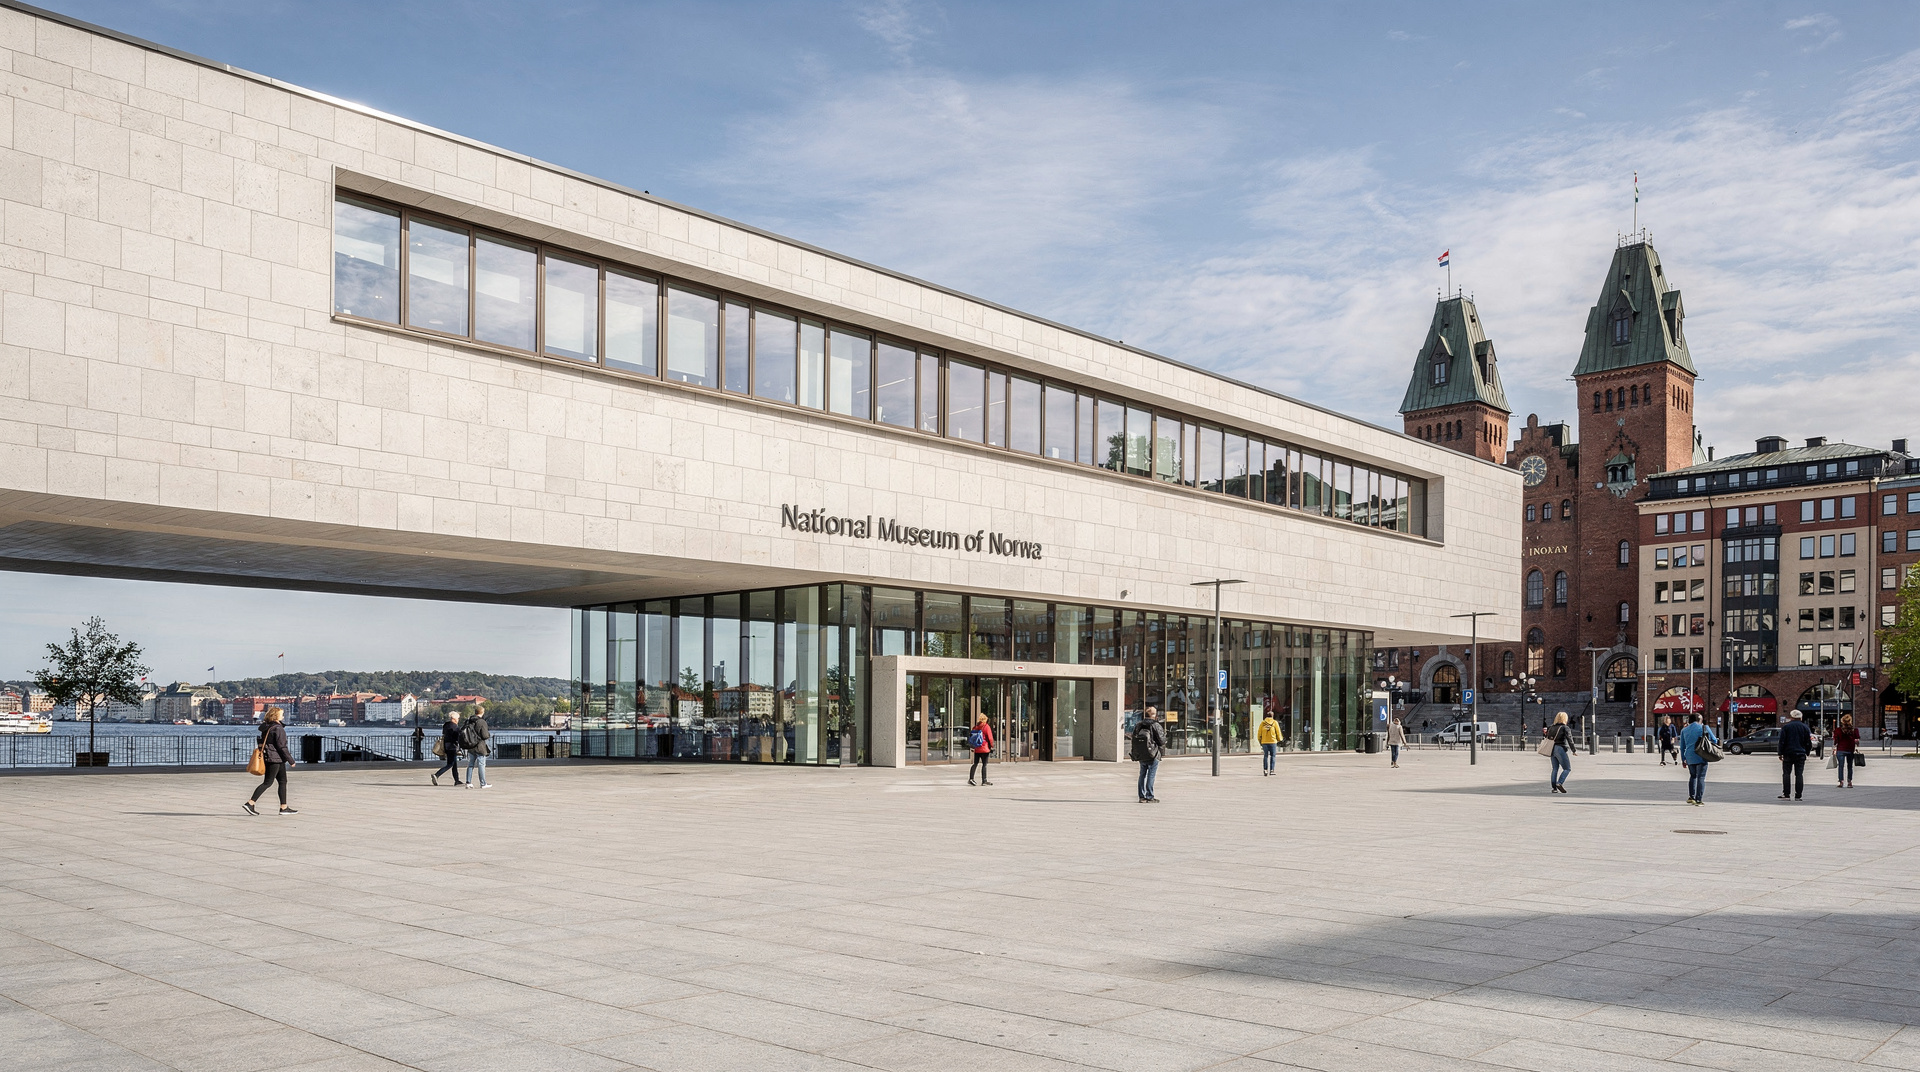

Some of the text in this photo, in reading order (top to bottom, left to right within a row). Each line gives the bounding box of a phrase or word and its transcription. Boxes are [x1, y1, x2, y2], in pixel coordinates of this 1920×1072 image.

[878, 517, 960, 550] Museum
[964, 529, 984, 553] of
[988, 532, 1042, 560] Norwa
